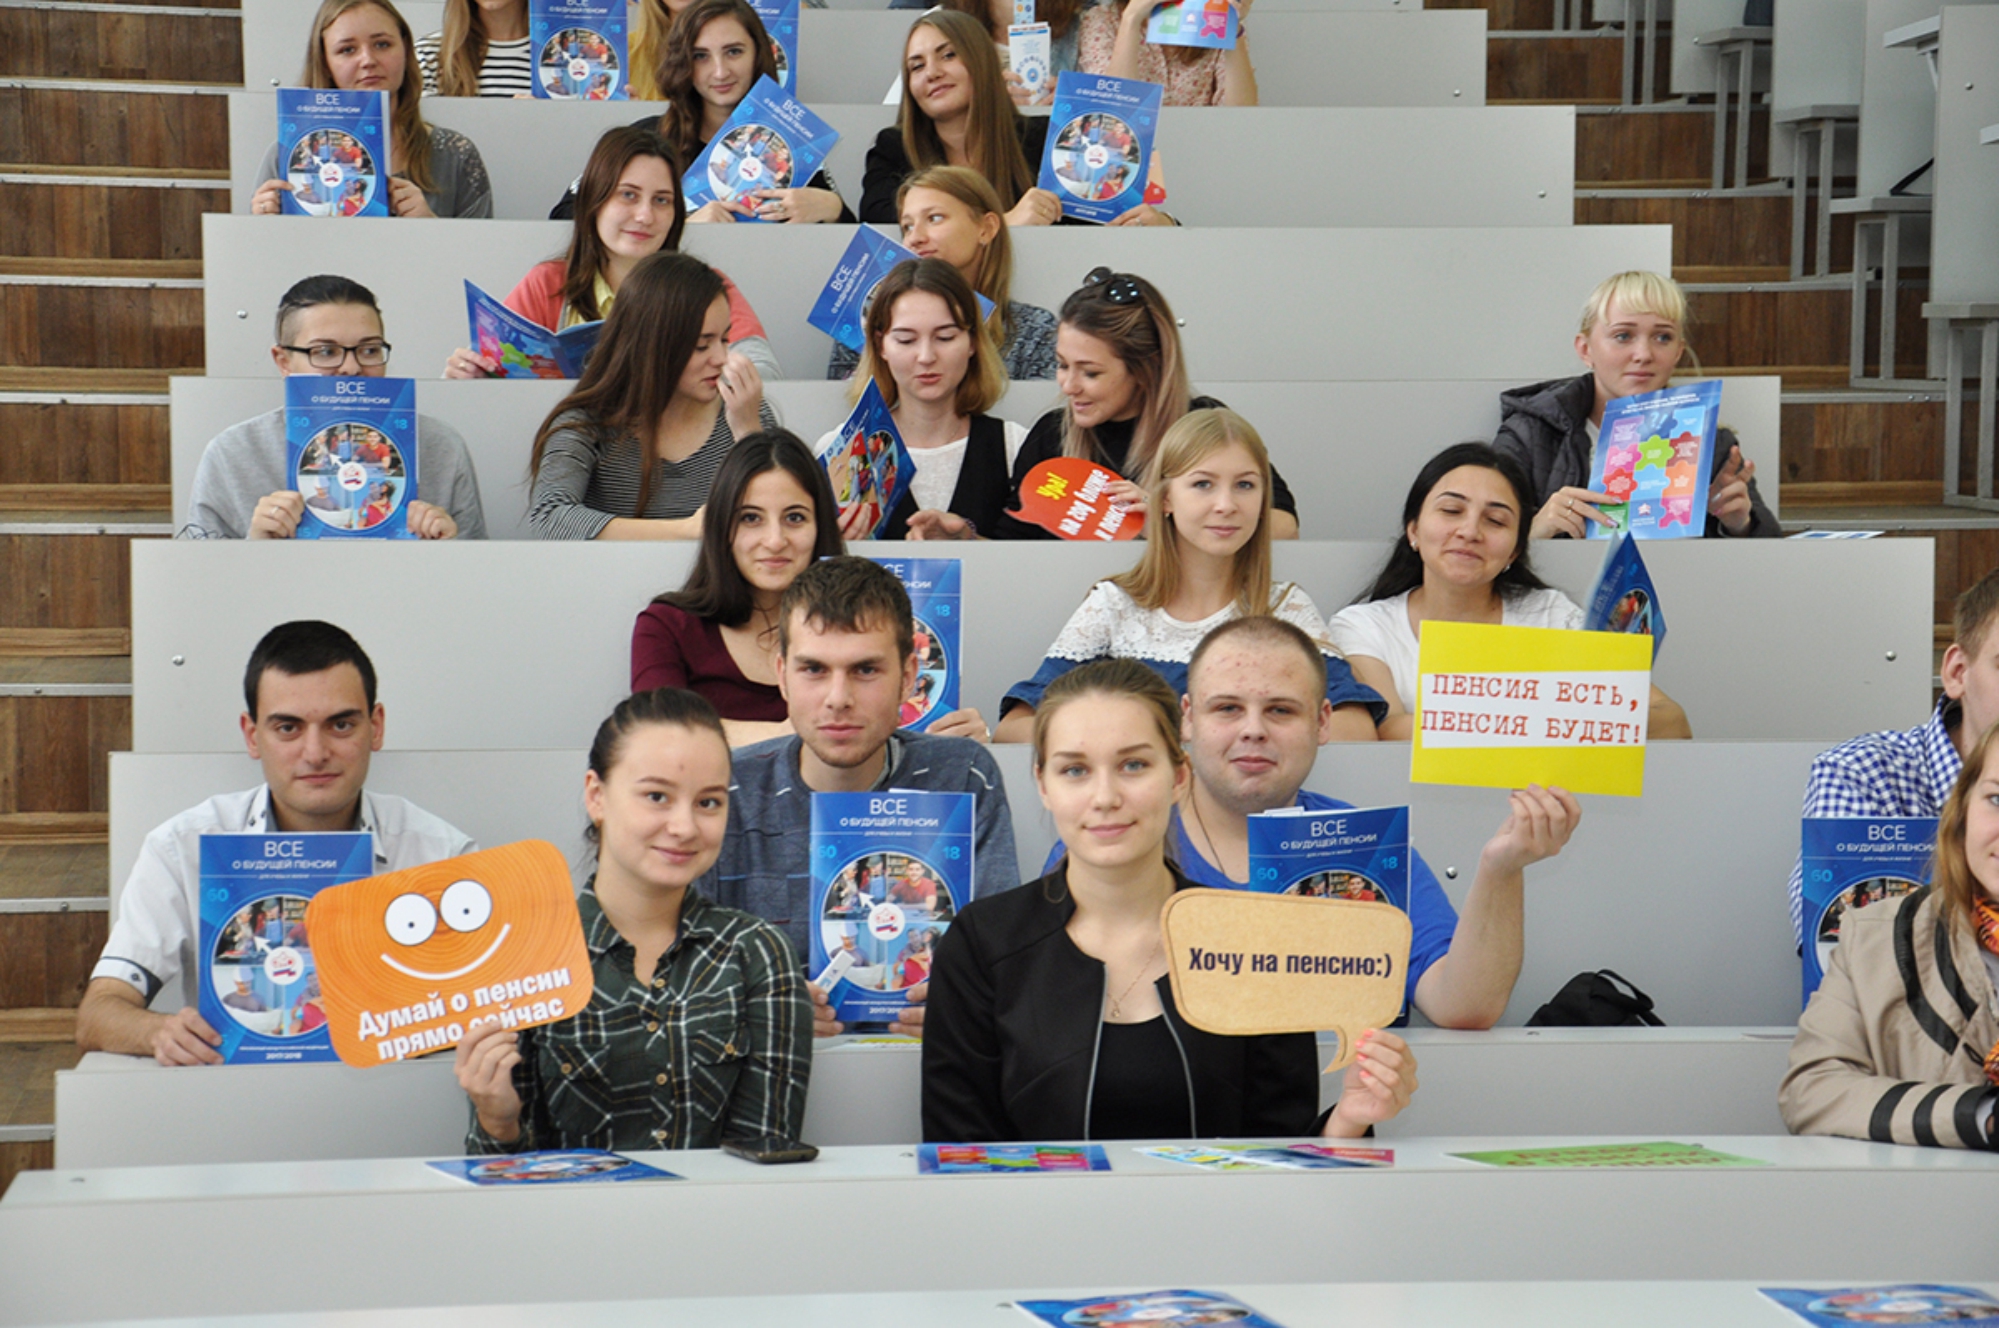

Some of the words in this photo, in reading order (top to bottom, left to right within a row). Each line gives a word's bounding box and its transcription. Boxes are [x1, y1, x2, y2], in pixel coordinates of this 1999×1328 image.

[1096, 79, 1122, 92] ВСЕ
[316, 93, 340, 105] ВСЕ
[782, 99, 806, 121] ВСЕ
[831, 264, 852, 292] ВСЕ
[336, 381, 366, 395] ВСЕ
[935, 604, 951, 617] 18
[1432, 674, 1540, 701] ПЕНСИЯ
[1555, 681, 1639, 712] ЕСТЬ,
[1421, 709, 1529, 737] ПЕНСИЯ
[1545, 717, 1641, 745] БУДЕТ!
[870, 798, 908, 815] ВСЕ
[840, 818, 849, 827] О
[1310, 819, 1347, 837] ВСЕ
[1868, 824, 1906, 841] ВСЕ
[264, 841, 304, 857] ВСЕ
[944, 846, 961, 860] 18
[1280, 841, 1289, 850] О
[1836, 843, 1845, 852] О
[232, 861, 242, 870] О
[1256, 867, 1278, 881] 60
[1381, 856, 1398, 870] 18
[1811, 869, 1833, 882] 60
[207, 888, 229, 902] 60
[1189, 947, 1244, 975] Хочу
[1251, 953, 1278, 973] на
[1286, 953, 1392, 978] пенсию:)
[358, 991, 446, 1041] Думай
[451, 993, 469, 1013] о
[473, 967, 572, 1008] пенсии
[377, 1022, 464, 1061] прямо
